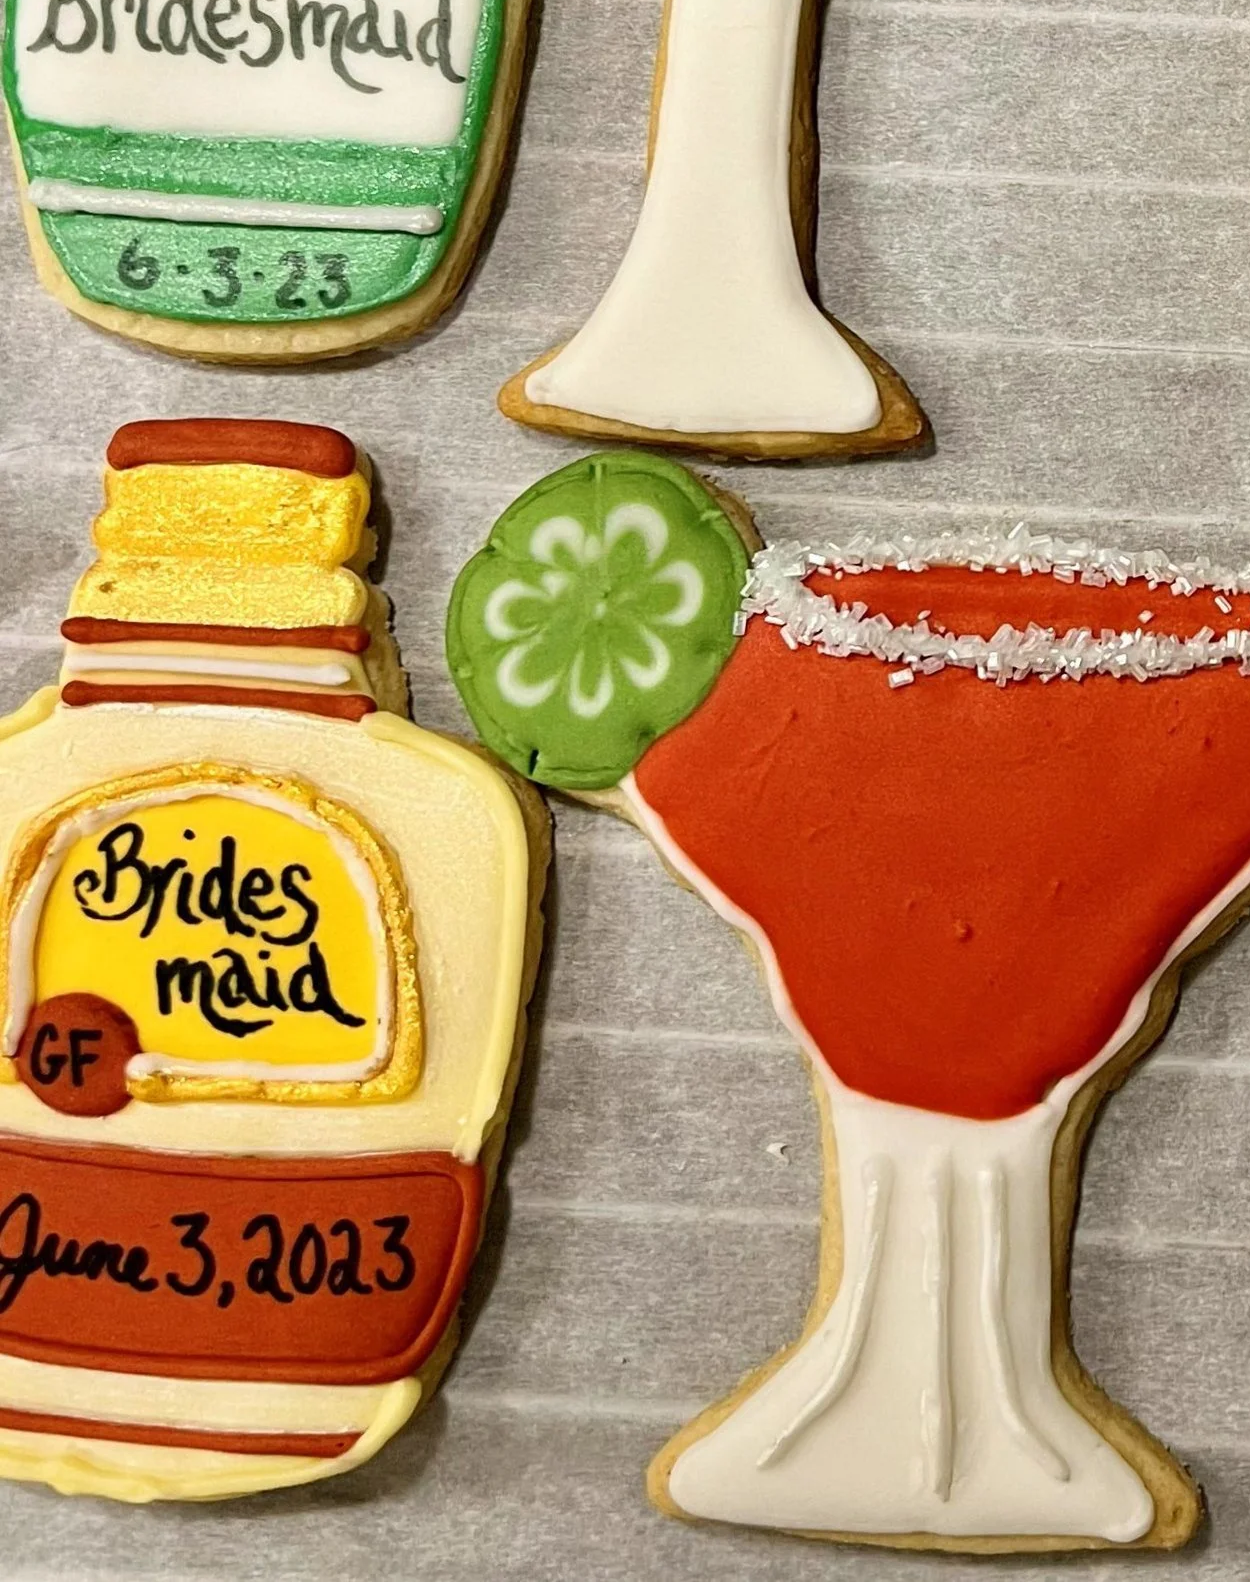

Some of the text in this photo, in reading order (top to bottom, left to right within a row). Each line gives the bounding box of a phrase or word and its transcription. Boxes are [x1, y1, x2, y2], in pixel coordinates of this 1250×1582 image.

[74, 822, 319, 945] Brides
[155, 942, 366, 1037] maid
[29, 1029, 102, 1086] GF
[0, 1193, 158, 1314] June
